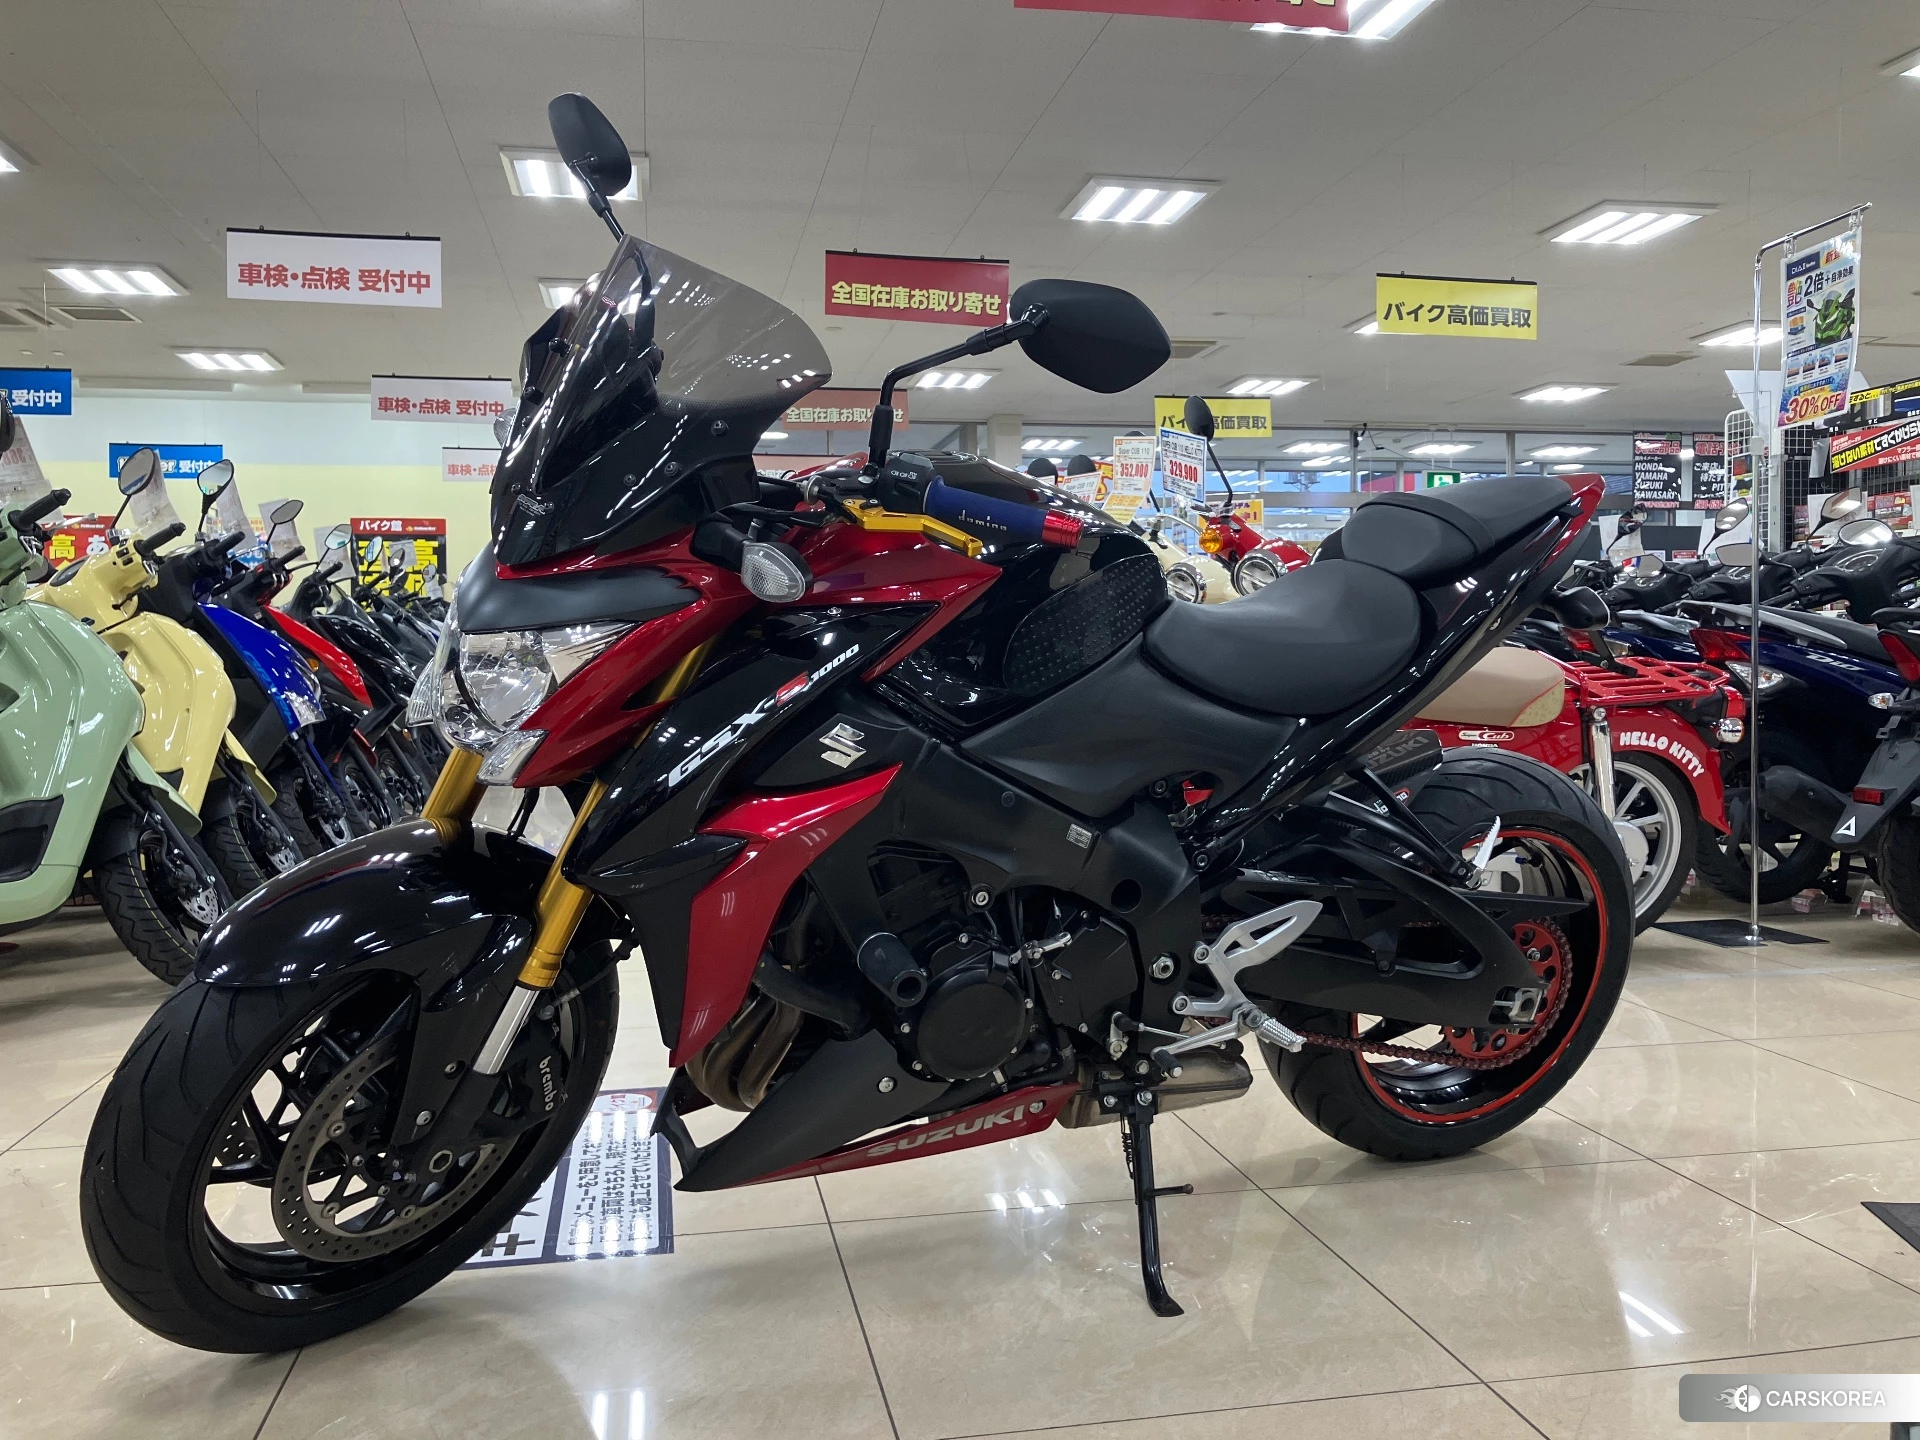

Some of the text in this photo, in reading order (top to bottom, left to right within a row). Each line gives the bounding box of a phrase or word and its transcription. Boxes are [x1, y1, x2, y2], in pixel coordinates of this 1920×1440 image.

[238, 263, 431, 294] 車検・点検 受付中
[832, 281, 1001, 315] 全国在庫お取り寄せ
[1383, 302, 1531, 328] バイク高価買取
[11, 389, 62, 408] 受付中
[378, 397, 504, 416] 車検・点検 受付中
[787, 407, 903, 423] 全国在庫お取せ
[1170, 459, 1197, 483] 329,900
[1635, 472, 1667, 480] YAMAHA
[1635, 491, 1674, 499] KAWASAKI
[1367, 737, 1428, 768] ZUKI
[1620, 731, 1704, 777] HELLO KITTY
[539, 1056, 557, 1111] brembo
[867, 1105, 1024, 1157] SUZUKI
